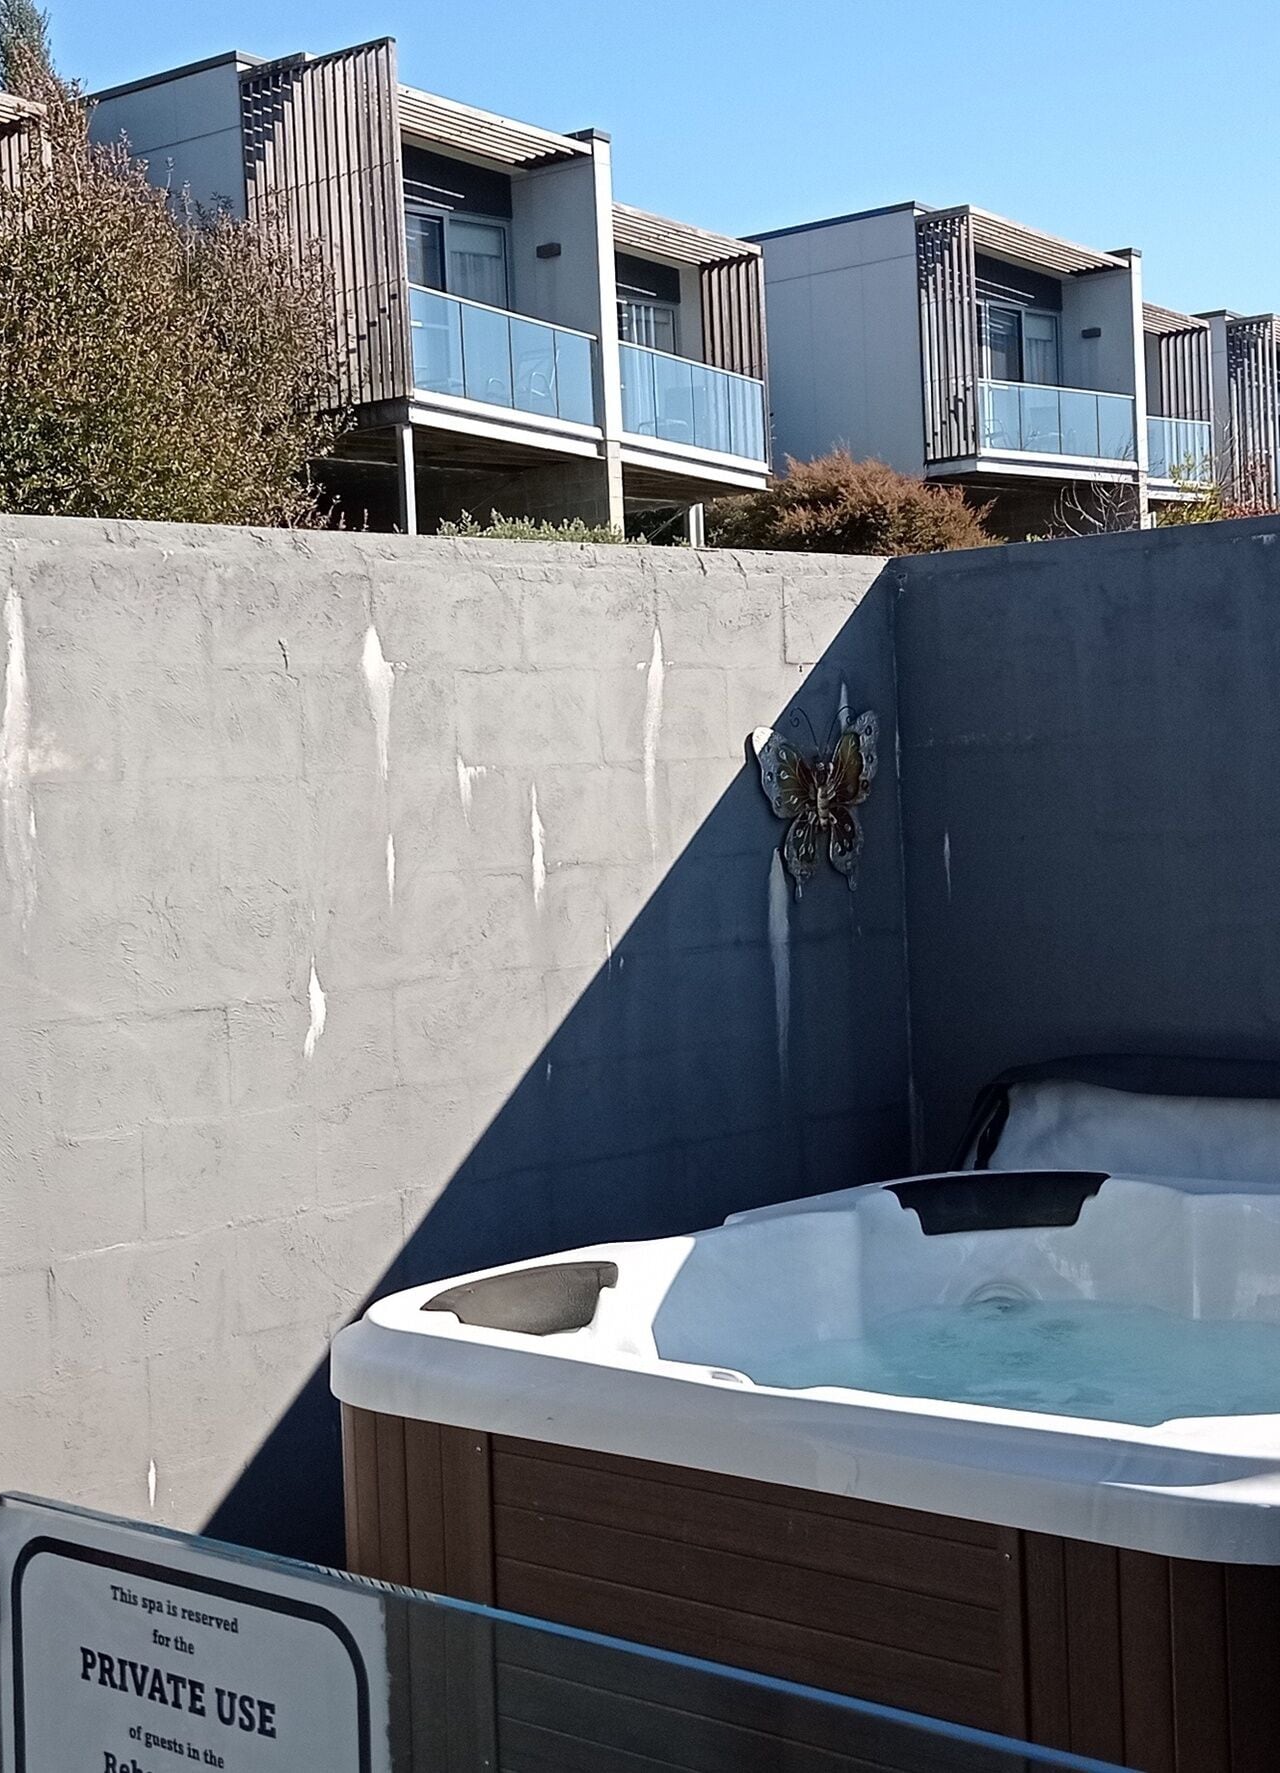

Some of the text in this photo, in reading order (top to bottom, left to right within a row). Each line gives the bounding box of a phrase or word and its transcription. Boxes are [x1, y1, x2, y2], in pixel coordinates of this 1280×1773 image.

[110, 1584, 239, 1633] This spa is reserved
[152, 1629, 195, 1655] for the
[80, 1646, 277, 1739] PRIVATE USE
[129, 1725, 225, 1769] of guests in the
